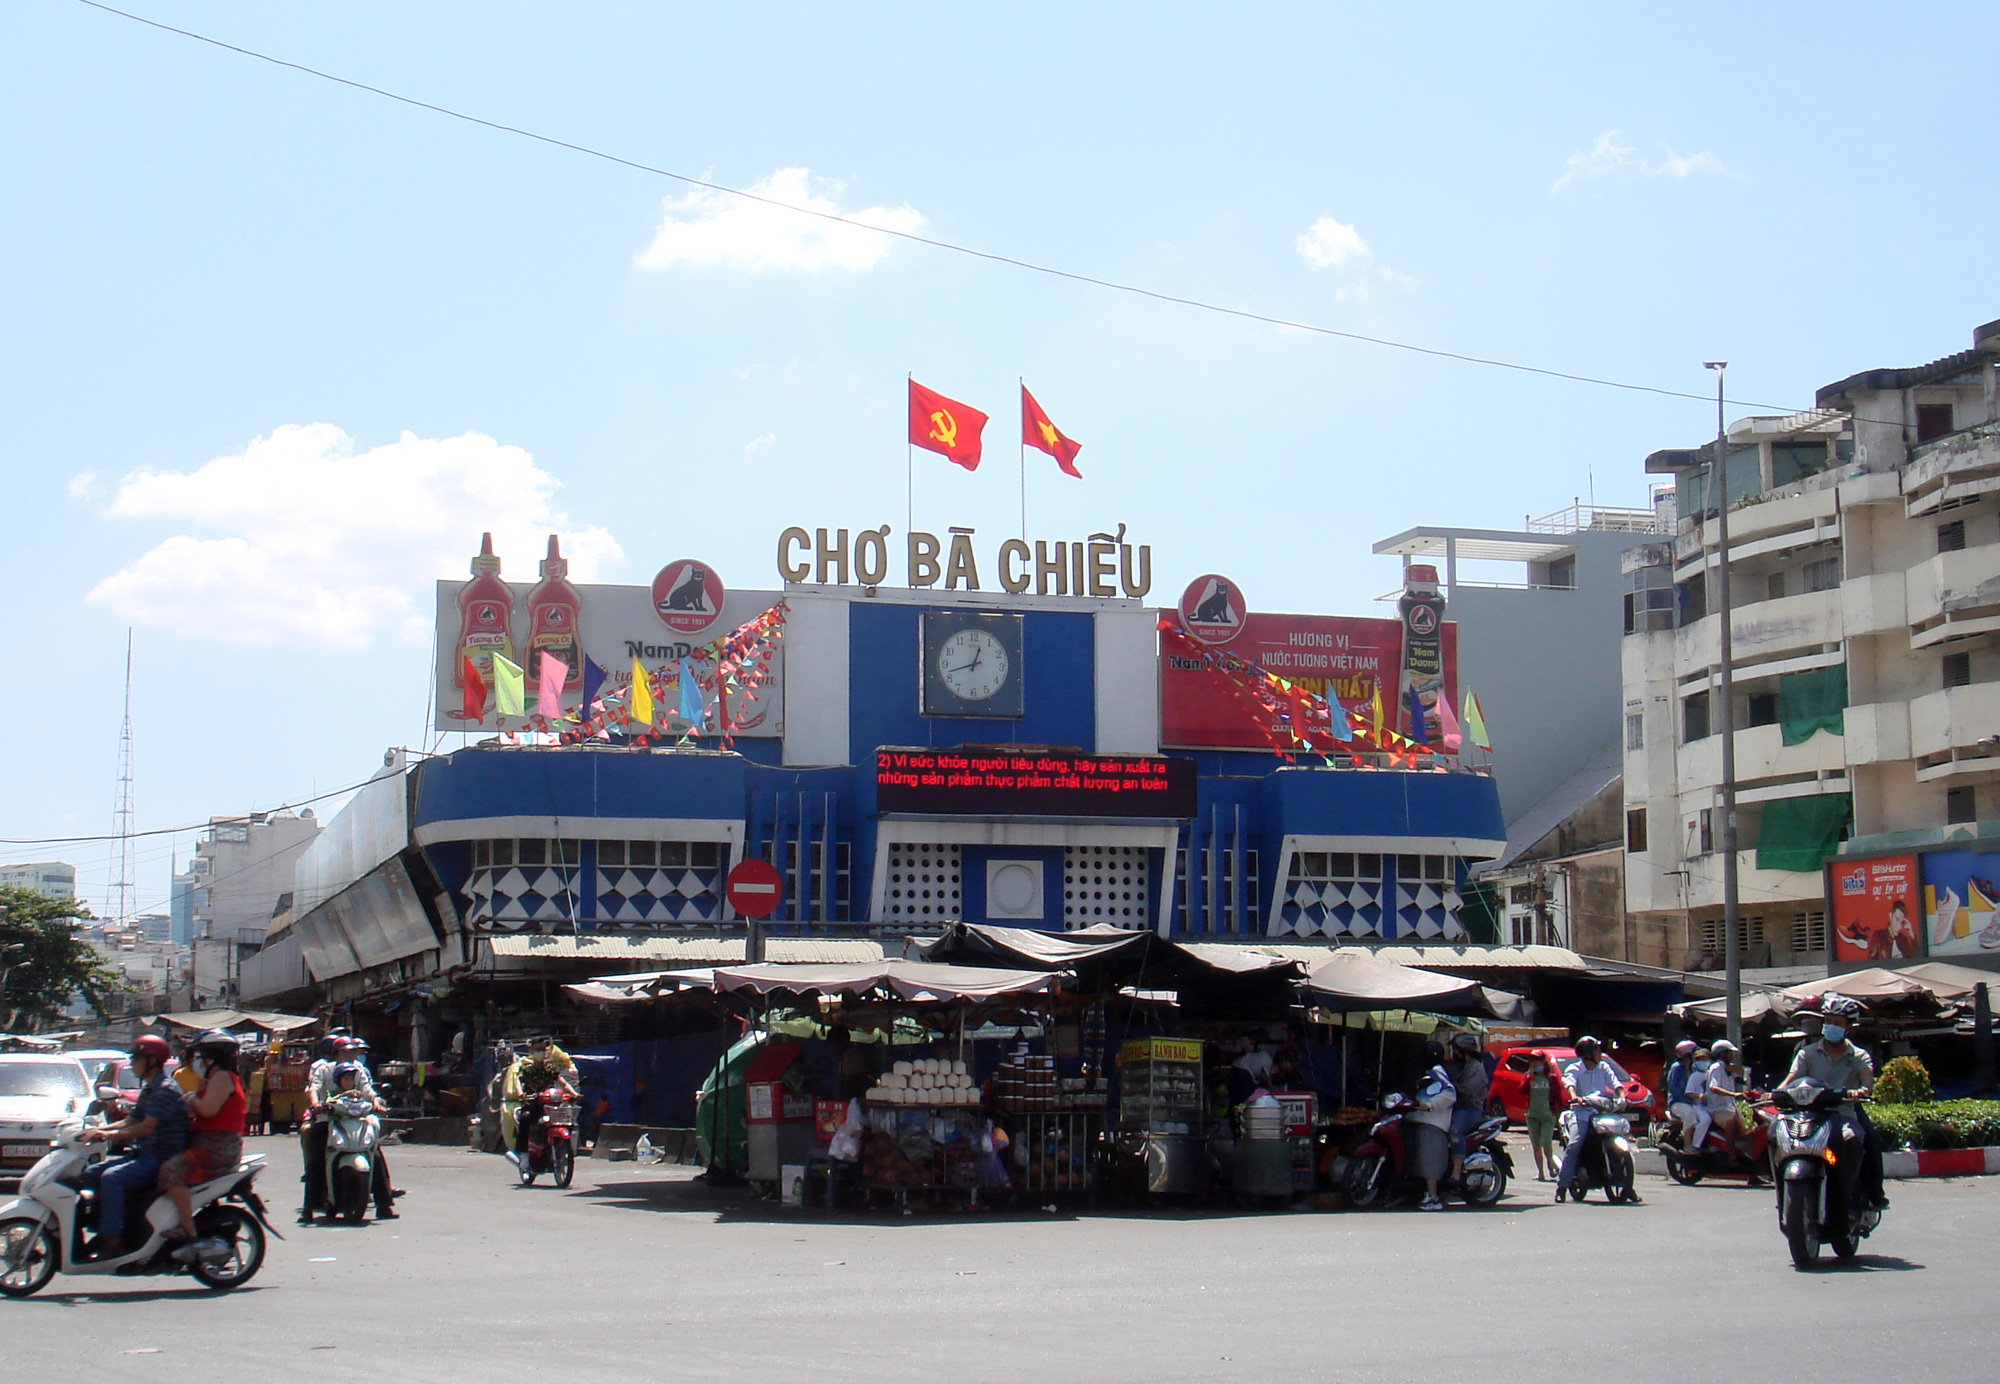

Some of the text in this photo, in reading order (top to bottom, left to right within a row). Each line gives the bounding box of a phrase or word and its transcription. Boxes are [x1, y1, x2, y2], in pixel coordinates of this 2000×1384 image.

[998, 523, 1151, 597] CHIỂU
[670, 617, 689, 625] SINCE
[956, 636, 964, 645] 11
[970, 633, 979, 642] 12
[1289, 632, 1349, 650] HƯƠNG VỊ
[987, 638, 991, 647] 1
[945, 647, 954, 656] 10
[996, 650, 1002, 659] 2
[1413, 647, 1435, 657] Nam
[942, 660, 949, 668] 9
[1262, 650, 1379, 671] NƯỚC TƯƠNG VIỆT NAM
[999, 662, 1005, 672] 3
[947, 674, 953, 683] 8
[993, 676, 999, 685] 4
[955, 683, 961, 692] 7
[983, 685, 989, 694] 5
[970, 688, 977, 697] 6
[878, 754, 890, 769] 2)
[910, 754, 935, 768] sức
[971, 756, 1008, 771] người
[1011, 757, 1033, 770] tiêu
[1125, 758, 1151, 773] xuất
[1153, 763, 1166, 773] ra
[878, 771, 918, 787] những
[921, 771, 945, 785] sản
[986, 773, 1014, 789] thực
[1054, 773, 1080, 788] chất
[1084, 775, 1120, 791] lượng
[1123, 779, 1138, 789] an
[1141, 777, 1168, 790] toàn
[1154, 1041, 1187, 1059] BÁNH BAO
